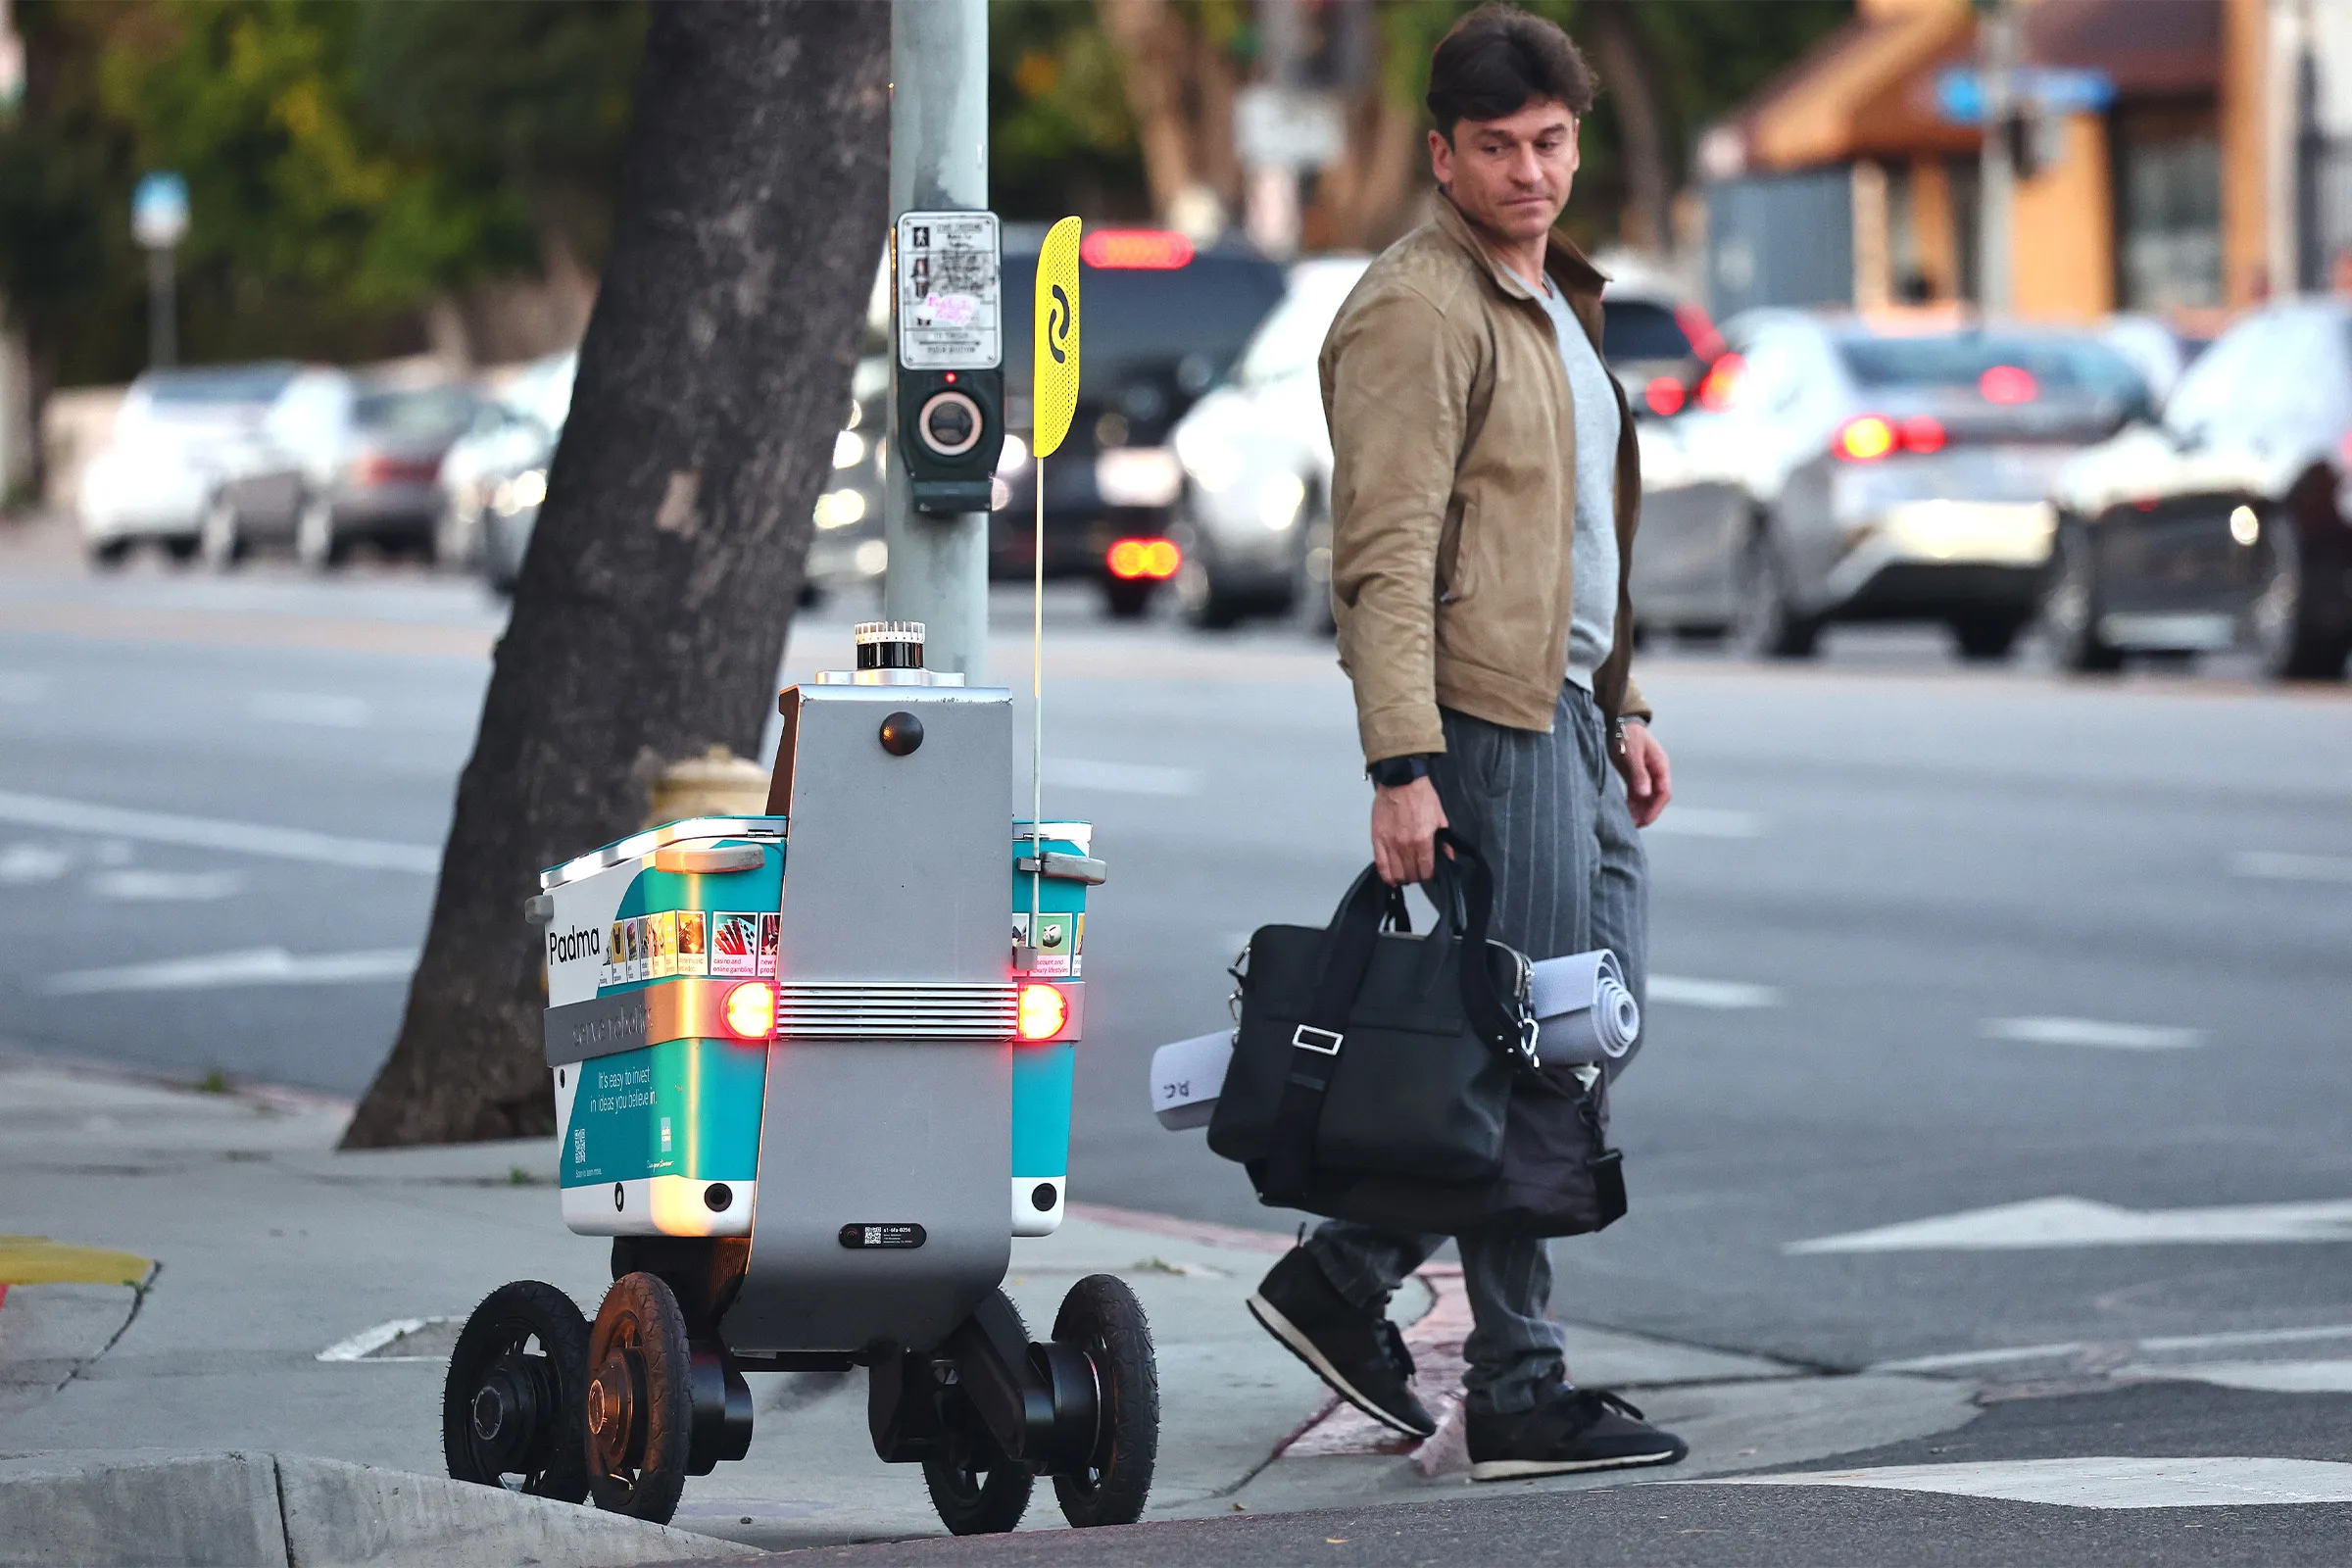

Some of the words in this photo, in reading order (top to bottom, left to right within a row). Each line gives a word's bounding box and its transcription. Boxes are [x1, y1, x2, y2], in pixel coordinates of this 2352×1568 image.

[550, 925, 600, 965] Padma
[730, 965, 754, 974] gambling
[572, 1020, 605, 1049] serve
[598, 1071, 609, 1089] It's
[609, 1072, 624, 1091] easy
[625, 1069, 632, 1086] to
[632, 1065, 651, 1084] invest
[590, 1095, 597, 1113] in
[598, 1093, 614, 1112] ideas
[614, 1095, 627, 1115] you
[628, 1088, 649, 1108] believe
